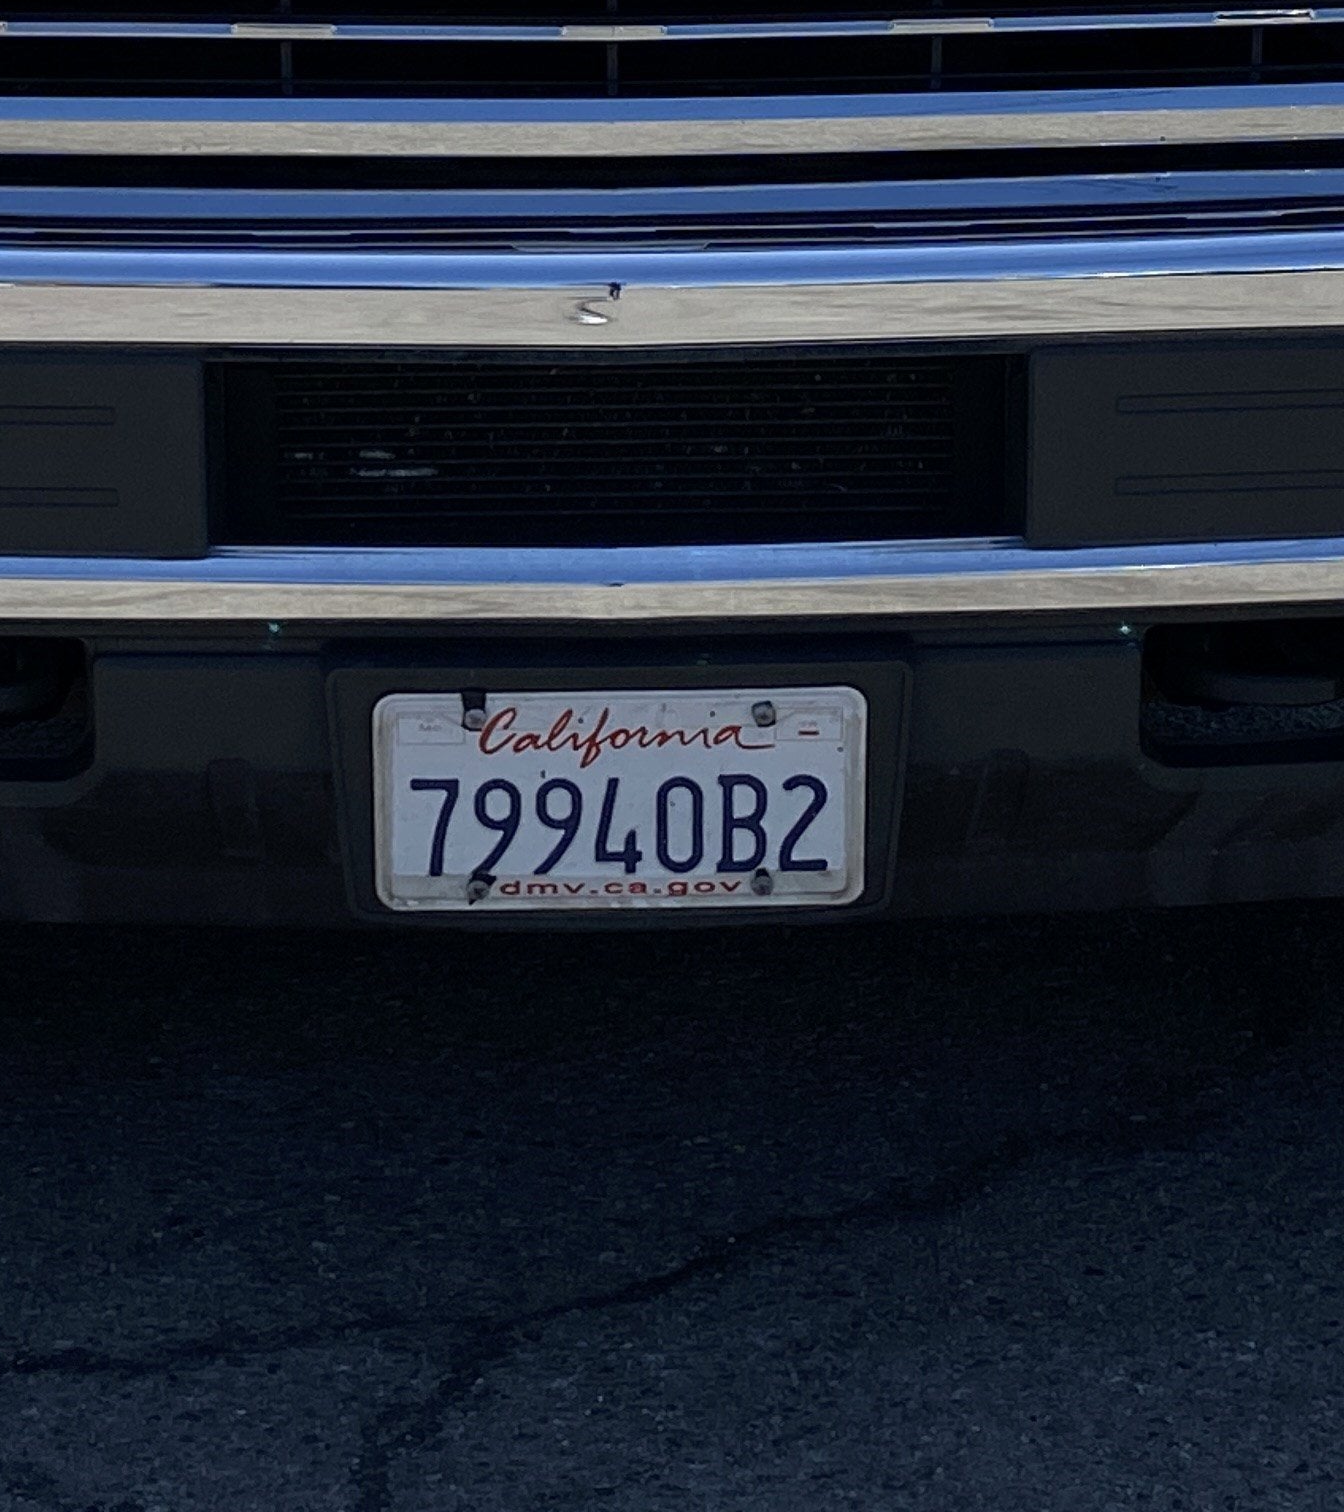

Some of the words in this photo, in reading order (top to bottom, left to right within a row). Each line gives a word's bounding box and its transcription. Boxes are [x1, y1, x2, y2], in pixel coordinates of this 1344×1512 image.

[477, 707, 776, 768] California
[409, 773, 829, 877] 79940B2
[498, 879, 742, 897] dmv.ca.gov
